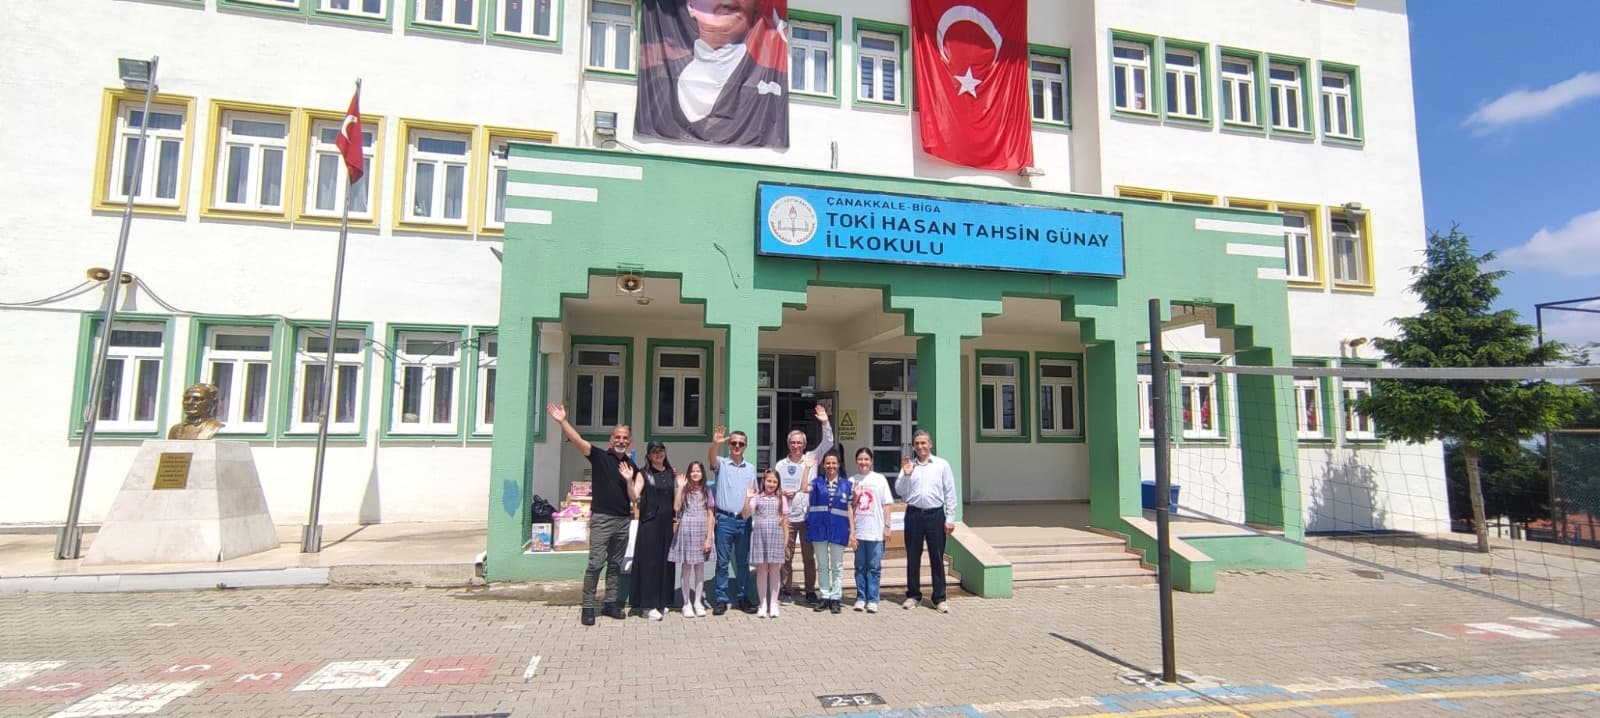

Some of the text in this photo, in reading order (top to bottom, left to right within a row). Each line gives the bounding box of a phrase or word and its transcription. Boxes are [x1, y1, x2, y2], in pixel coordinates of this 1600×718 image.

[826, 196, 941, 213] ÇANAKKALE-BİGA
[825, 211, 875, 230] TOKİ
[881, 215, 957, 236] HASAN
[962, 222, 1040, 242] TAHSİN
[1046, 227, 1109, 248] GÜNAY
[826, 230, 944, 256] İLKOKULU
